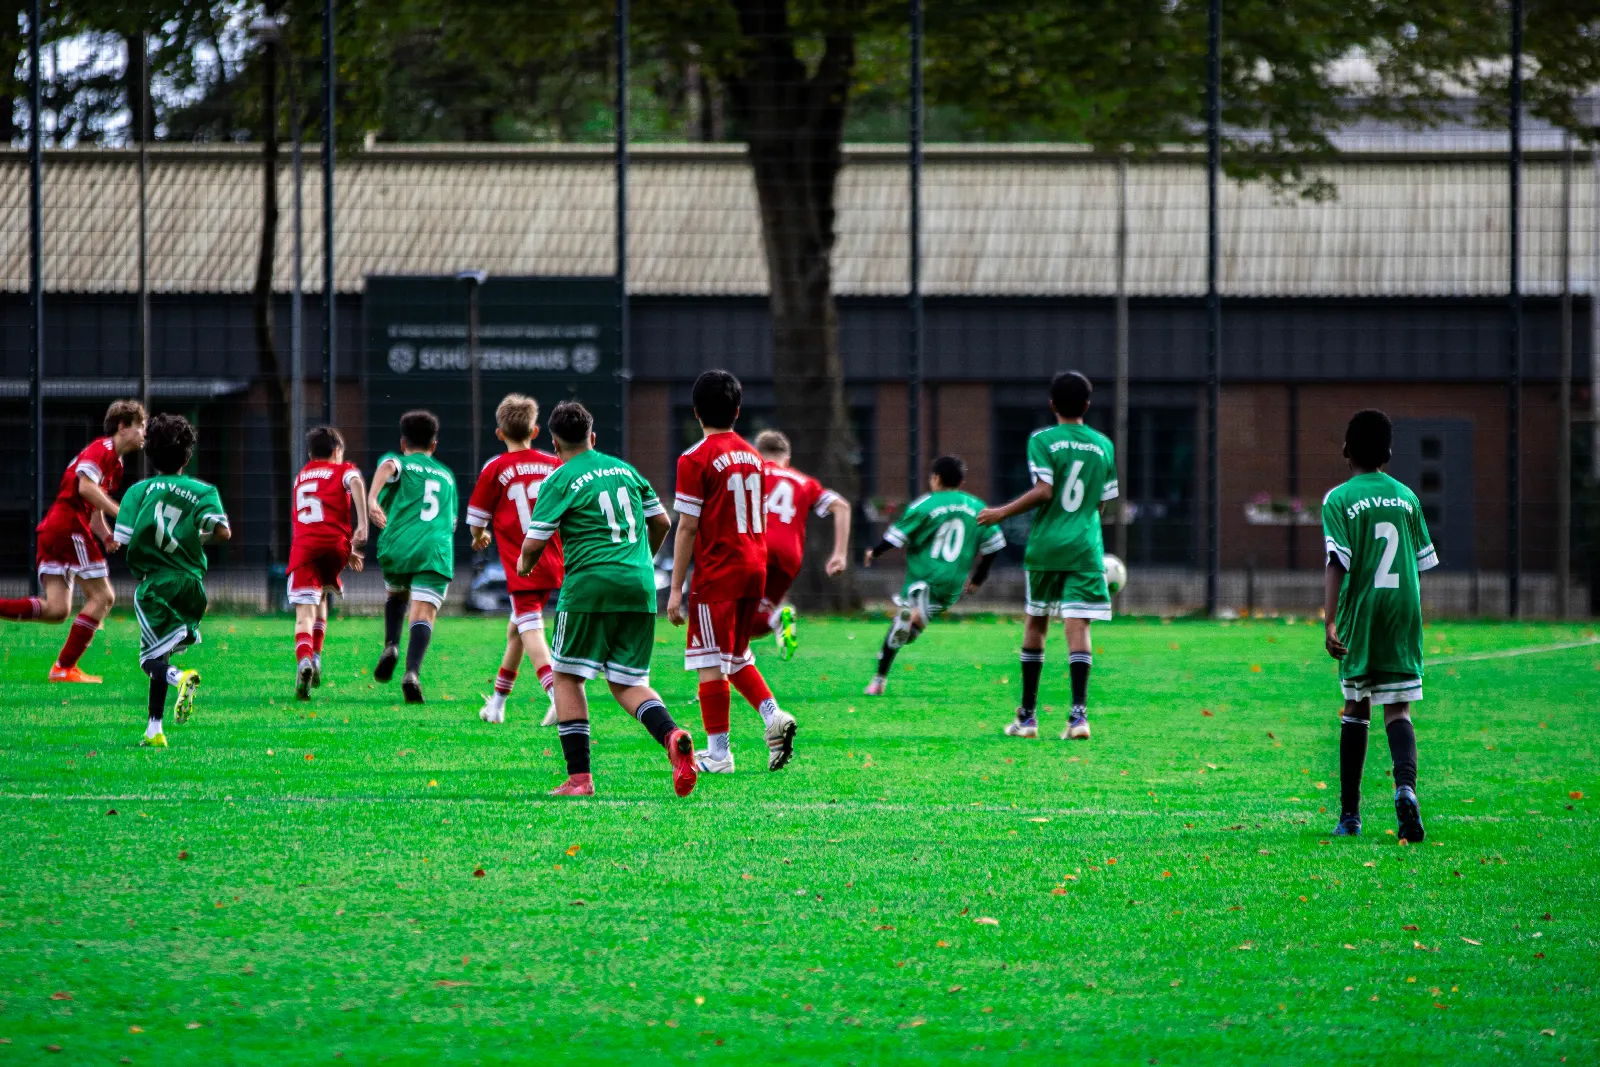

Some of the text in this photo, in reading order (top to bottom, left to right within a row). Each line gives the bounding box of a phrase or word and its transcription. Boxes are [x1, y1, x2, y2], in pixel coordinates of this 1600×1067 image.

[418, 344, 568, 370] SCHÜZENHAUS
[712, 450, 763, 473] RW DAMME
[1049, 440, 1069, 453] SFN
[299, 467, 335, 483] DAMME
[498, 466, 515, 486] RW
[570, 466, 633, 493] SFN Vechta
[1061, 459, 1085, 513] 6
[296, 481, 324, 525] 5
[419, 479, 441, 522] 5
[598, 486, 637, 544] 11
[727, 472, 763, 534] 11
[768, 479, 797, 525] 4
[1346, 497, 1371, 520] SFN
[154, 500, 183, 554] 17
[930, 518, 965, 563] 10
[1374, 521, 1400, 589] 2
